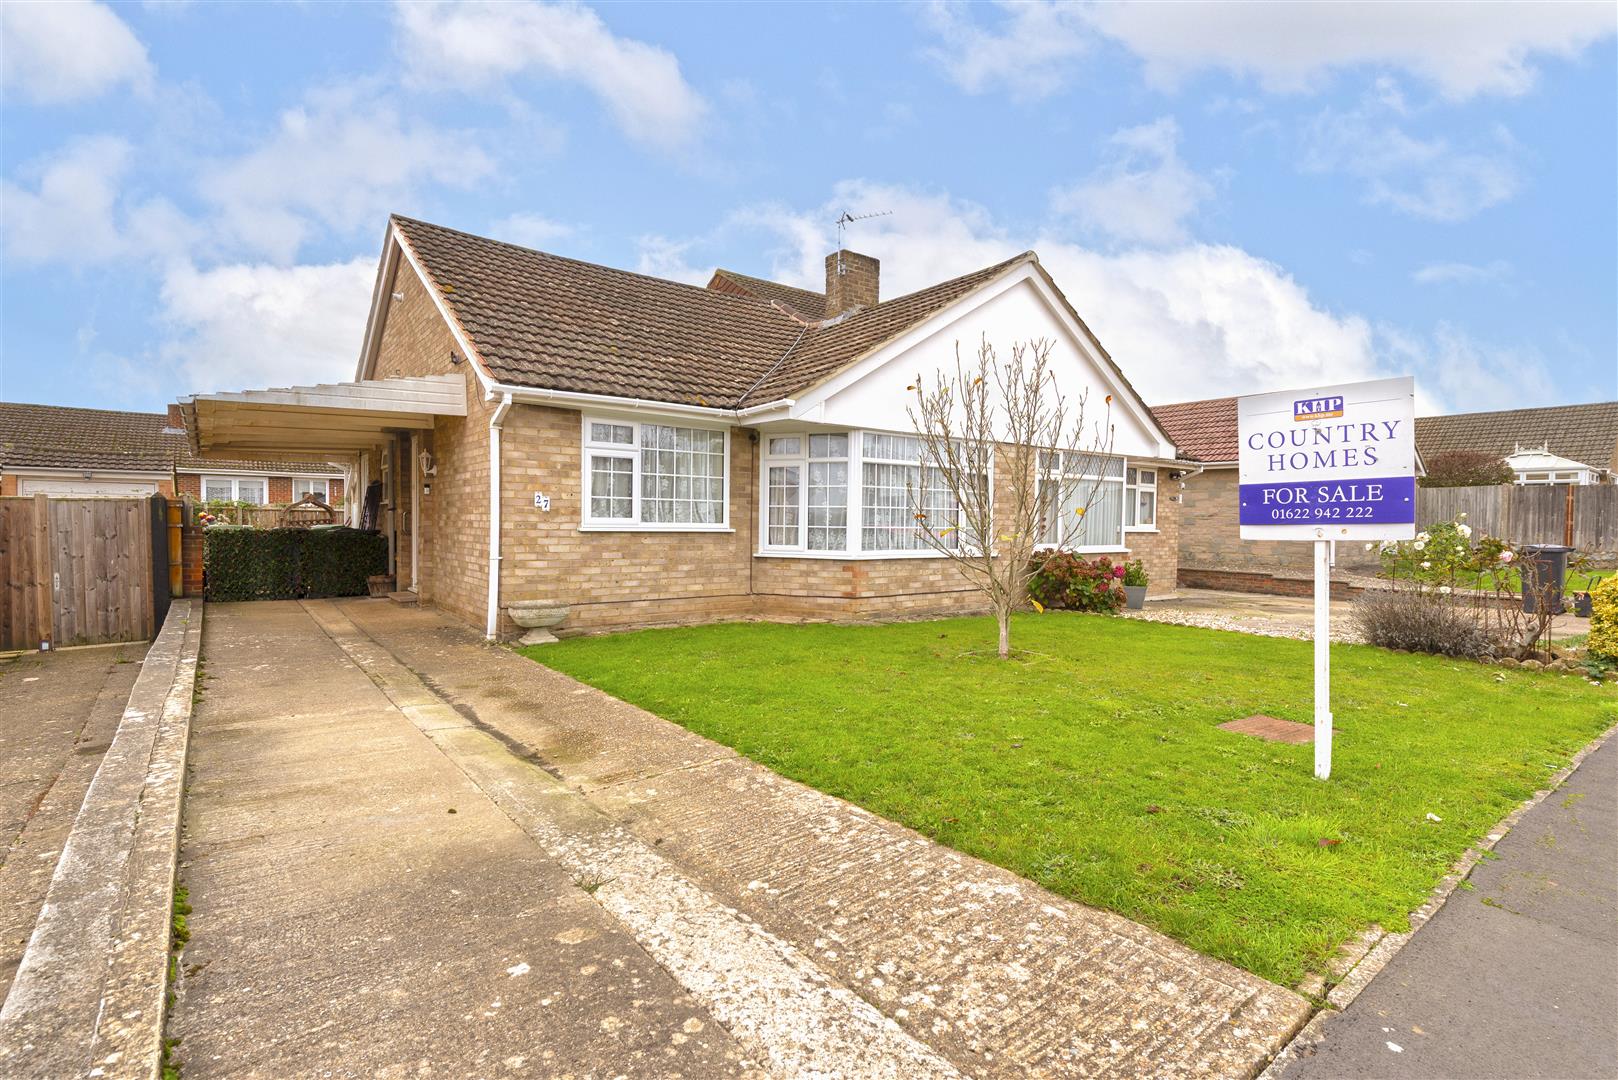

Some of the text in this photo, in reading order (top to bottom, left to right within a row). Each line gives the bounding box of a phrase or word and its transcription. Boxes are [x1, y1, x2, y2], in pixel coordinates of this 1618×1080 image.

[1296, 398, 1342, 415] KHP
[1248, 420, 1401, 450] COUNTRY
[1267, 446, 1378, 471] HOMES
[535, 495, 549, 508] 27
[1263, 484, 1384, 505] FOR SALE
[1271, 506, 1373, 519] 01622 942 222
